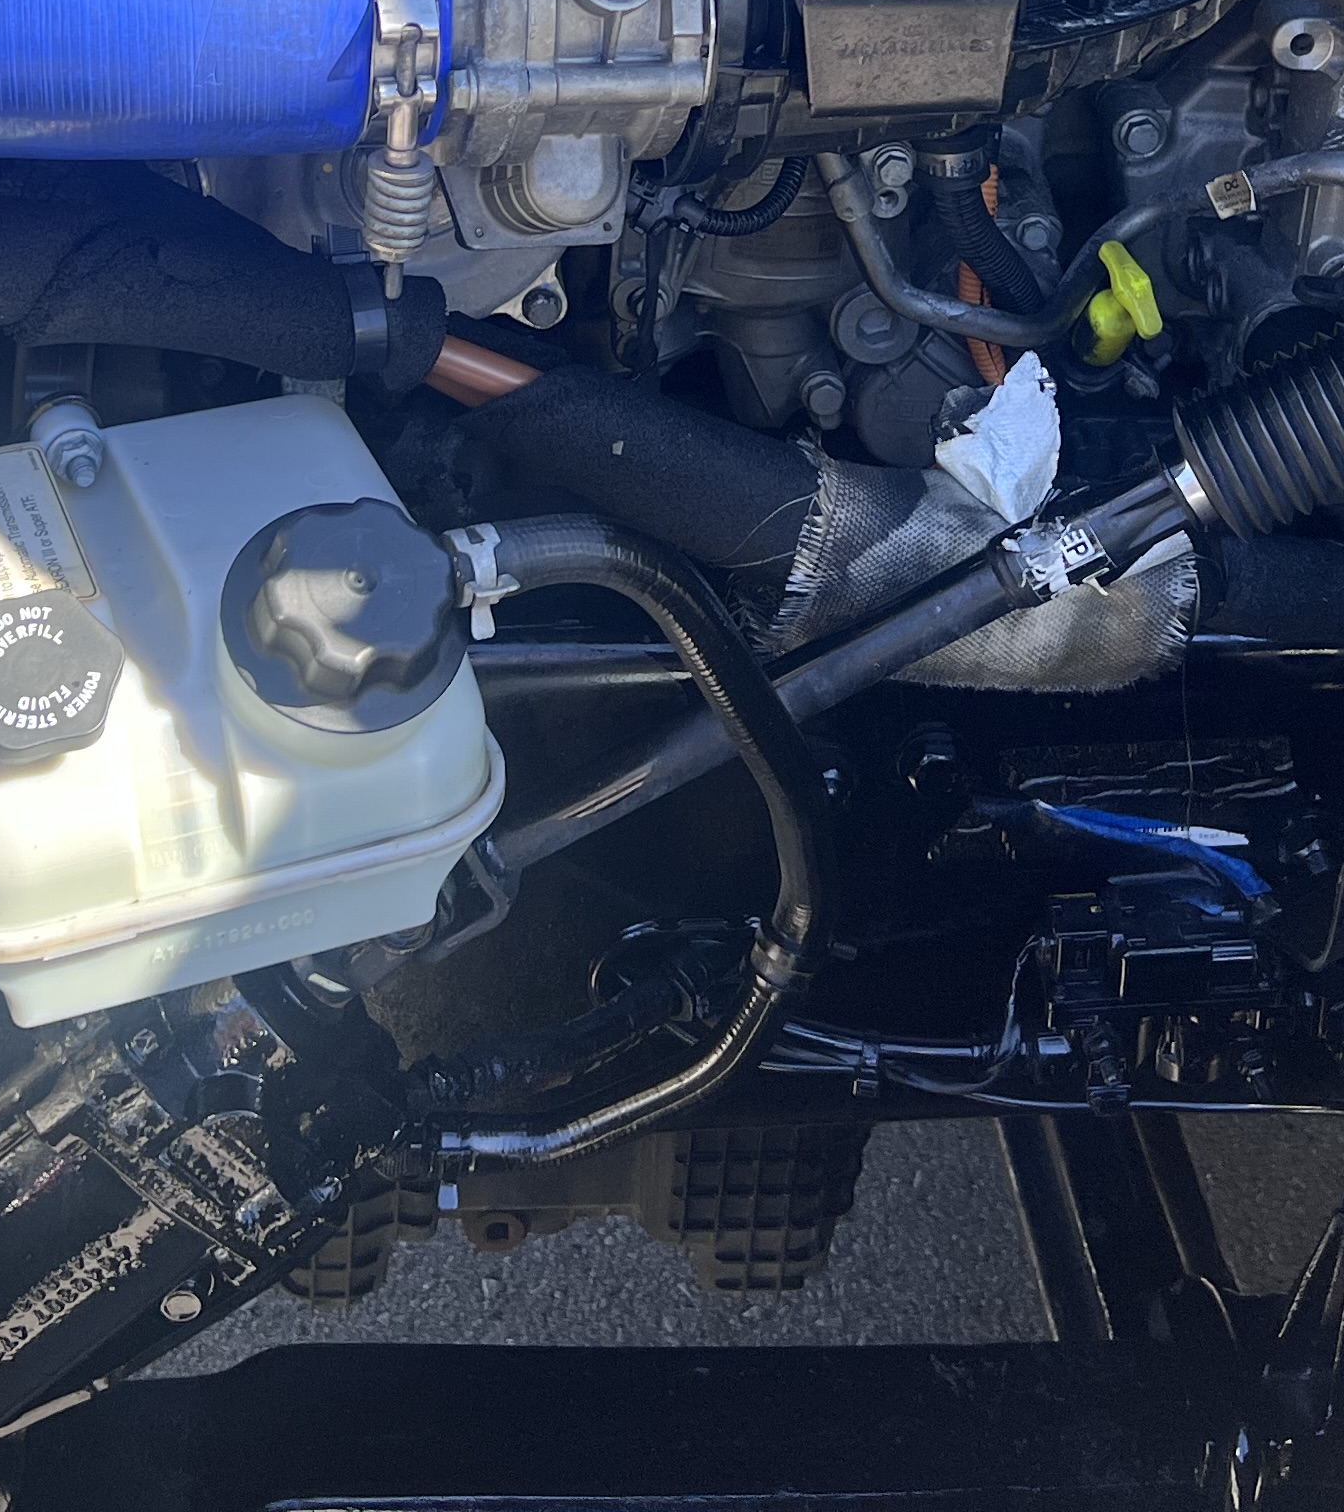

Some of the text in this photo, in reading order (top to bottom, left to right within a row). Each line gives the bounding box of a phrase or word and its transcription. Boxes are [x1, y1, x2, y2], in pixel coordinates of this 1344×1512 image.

[19, 606, 53, 621] NOT
[17, 684, 72, 711] FLUID
[62, 670, 102, 718] POWER
